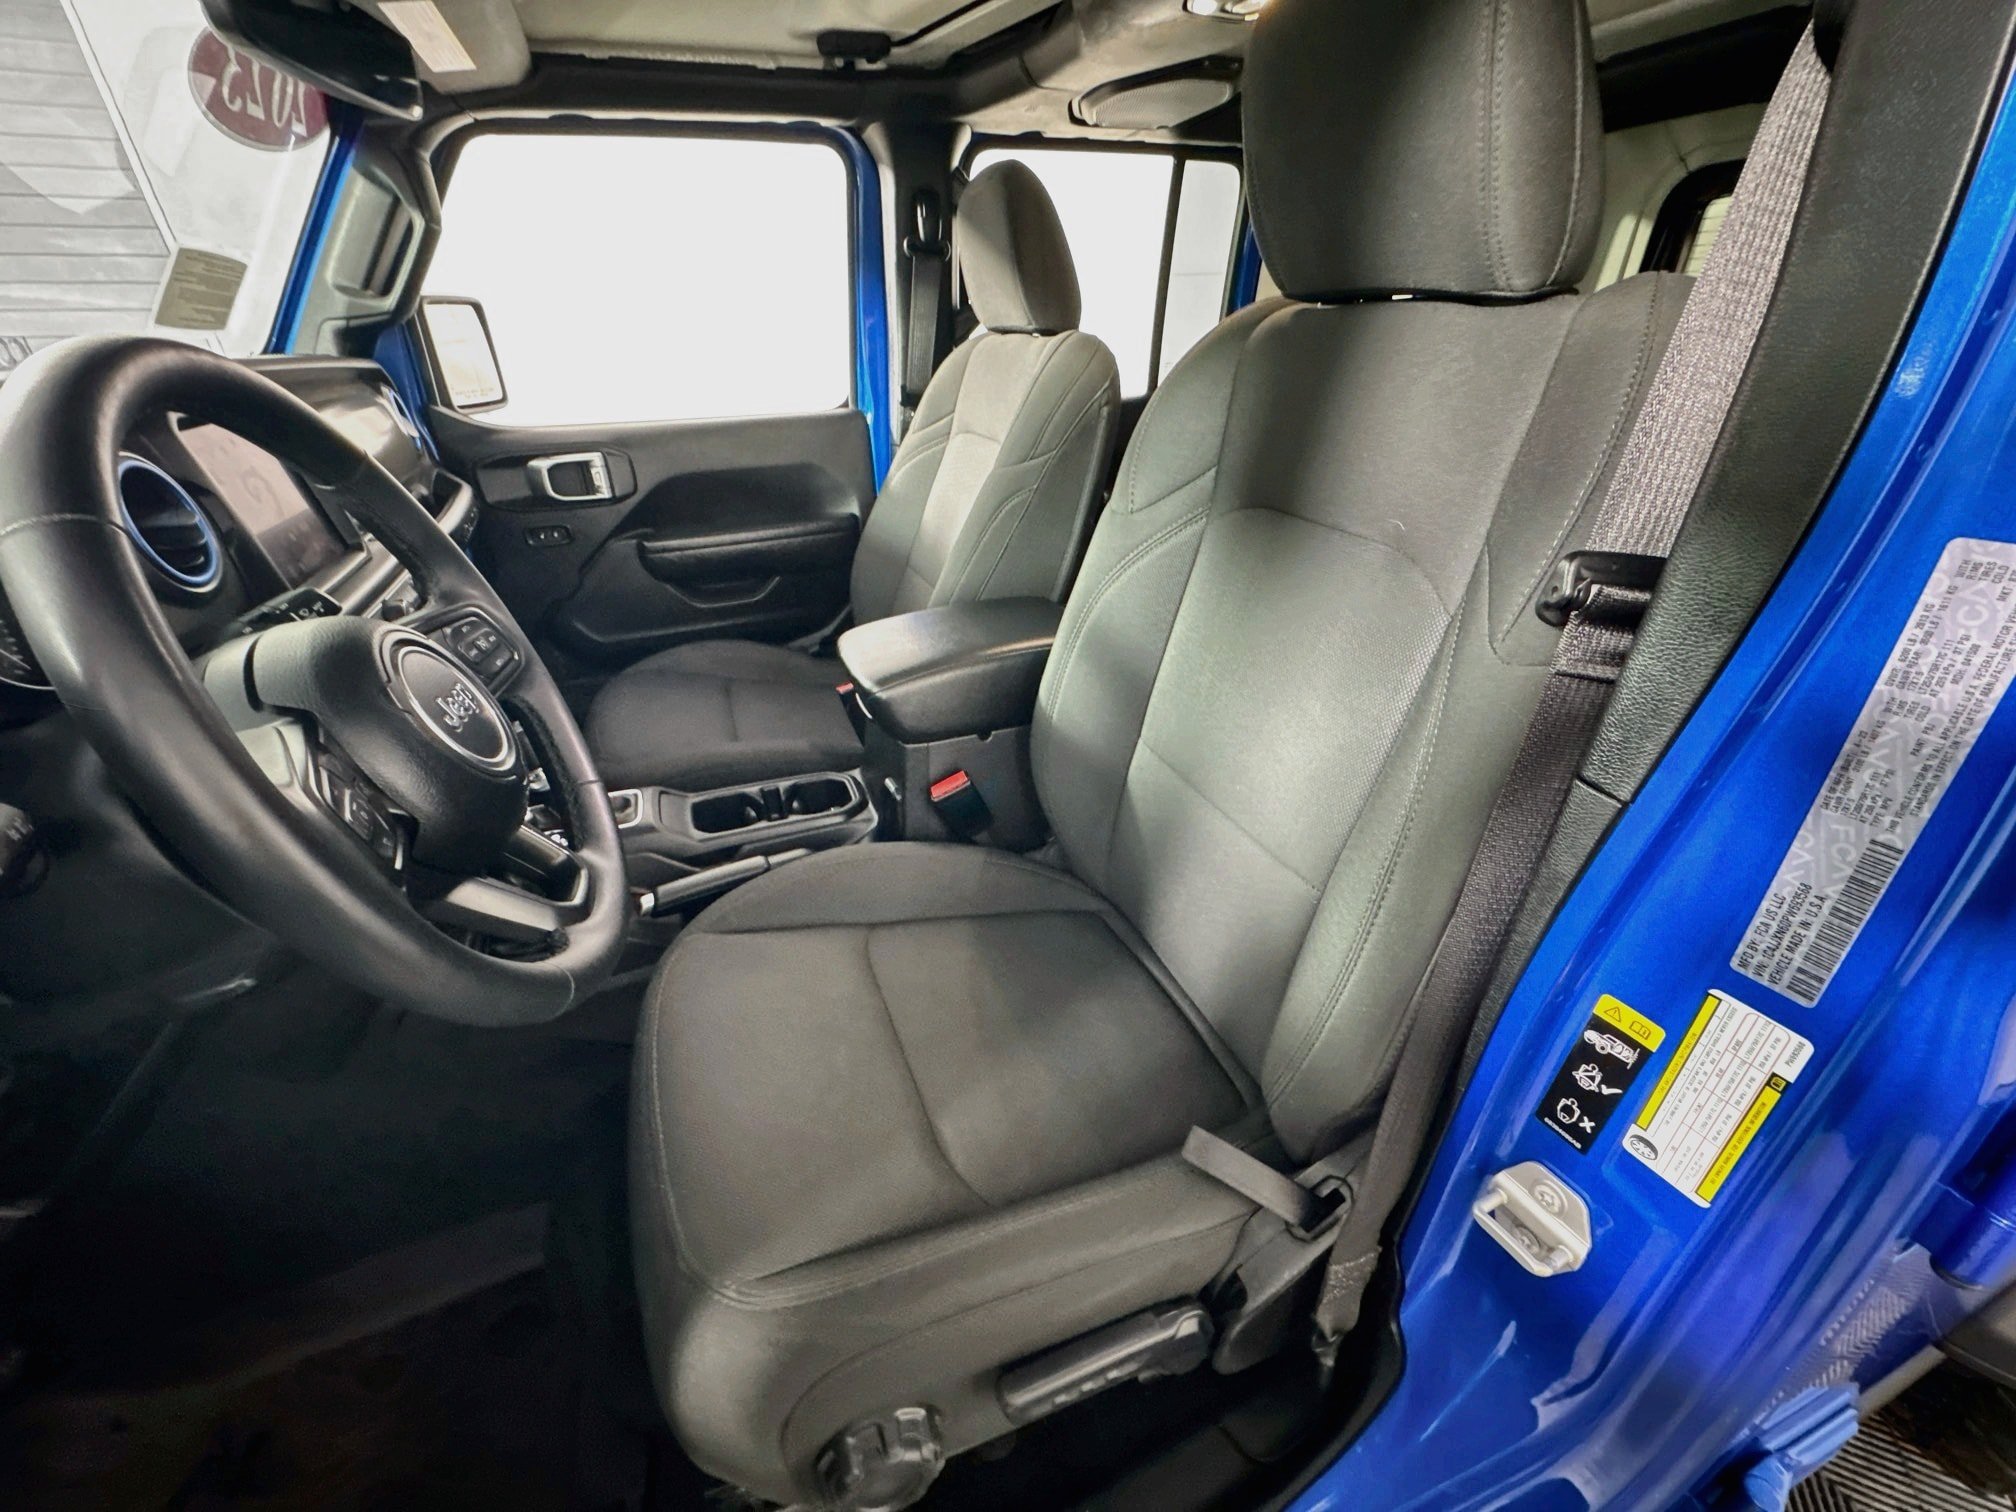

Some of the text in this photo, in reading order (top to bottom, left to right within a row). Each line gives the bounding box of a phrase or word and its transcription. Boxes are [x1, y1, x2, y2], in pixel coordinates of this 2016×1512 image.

[1953, 558, 1972, 578] WITH
[1965, 560, 1983, 580] RIMS
[1977, 560, 1997, 583] TIRES
[1991, 564, 2009, 584] COLD
[435, 682, 480, 732] Jeep
[1769, 893, 1787, 909] LLC
[1762, 908, 1779, 921] US
[1754, 920, 1772, 936] FCA
[1737, 952, 1755, 968] MFD
[1766, 953, 1794, 985] VEHICLE
[1784, 930, 1807, 954] MADE
